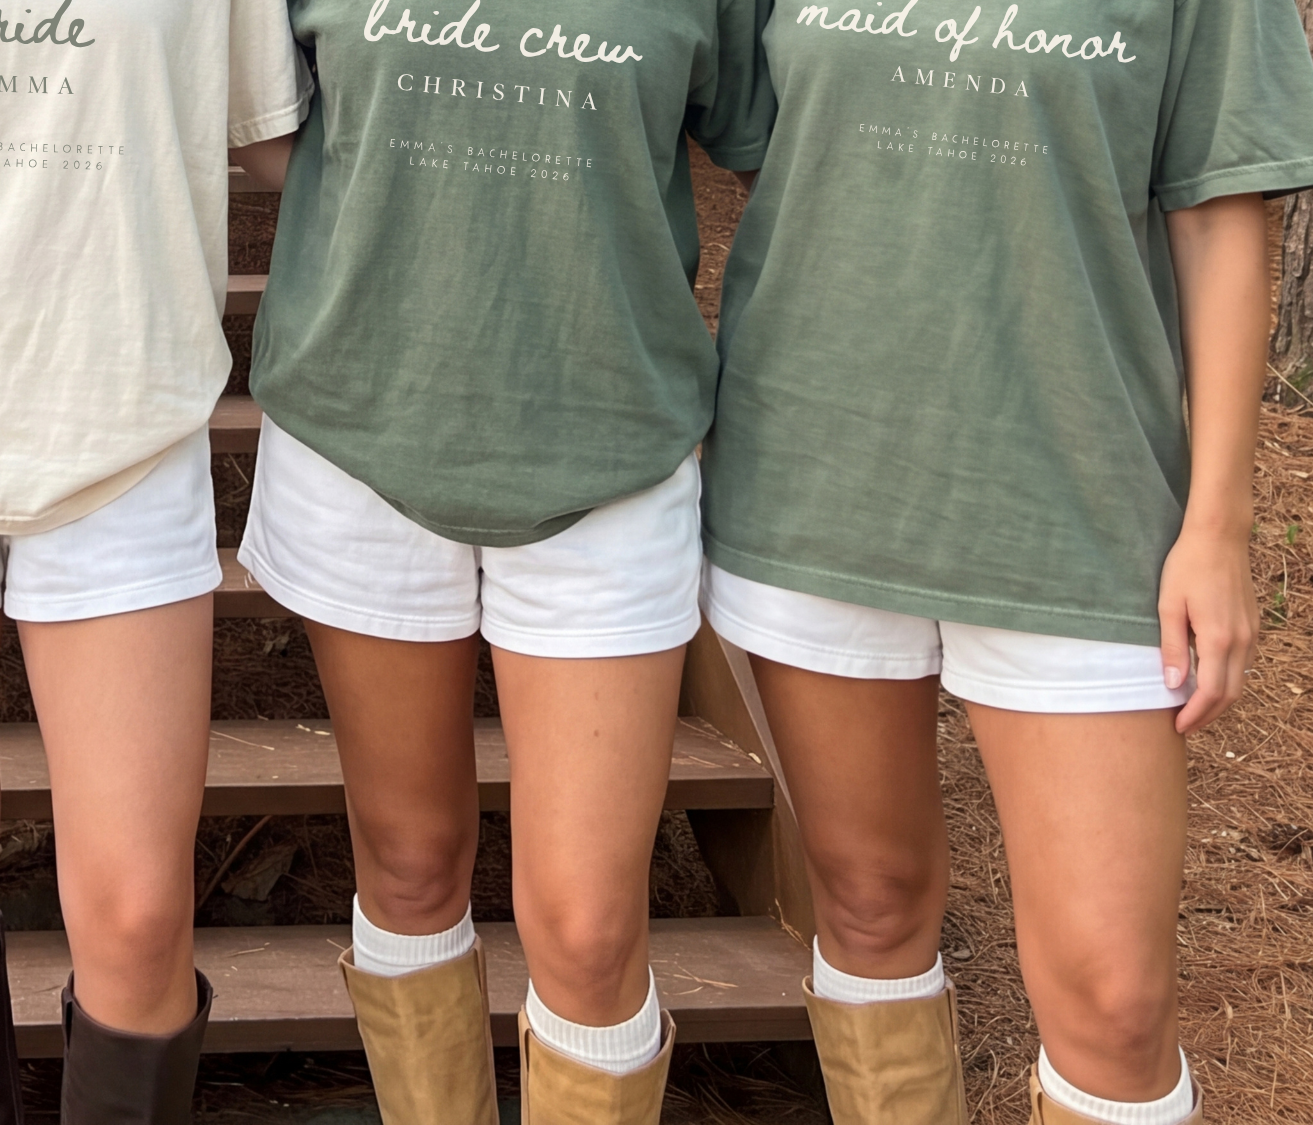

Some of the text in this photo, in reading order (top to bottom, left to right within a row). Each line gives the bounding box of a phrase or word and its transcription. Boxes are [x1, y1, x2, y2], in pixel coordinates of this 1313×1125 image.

[519, 24, 643, 64] crew
[934, 5, 981, 62] of
[992, 3, 1137, 63] honor
[397, 73, 598, 111] CHRISTINA
[891, 65, 1030, 98] AMENDA
[389, 138, 593, 168] EMMA'S BACHELORETTE
[859, 123, 1049, 155] EMMA'S BACHELORETTE
[877, 140, 1027, 167] LAKE TAHOE 2026
[62, 160, 103, 171] 2026
[409, 156, 570, 181] LAKE TAHOE 2026
